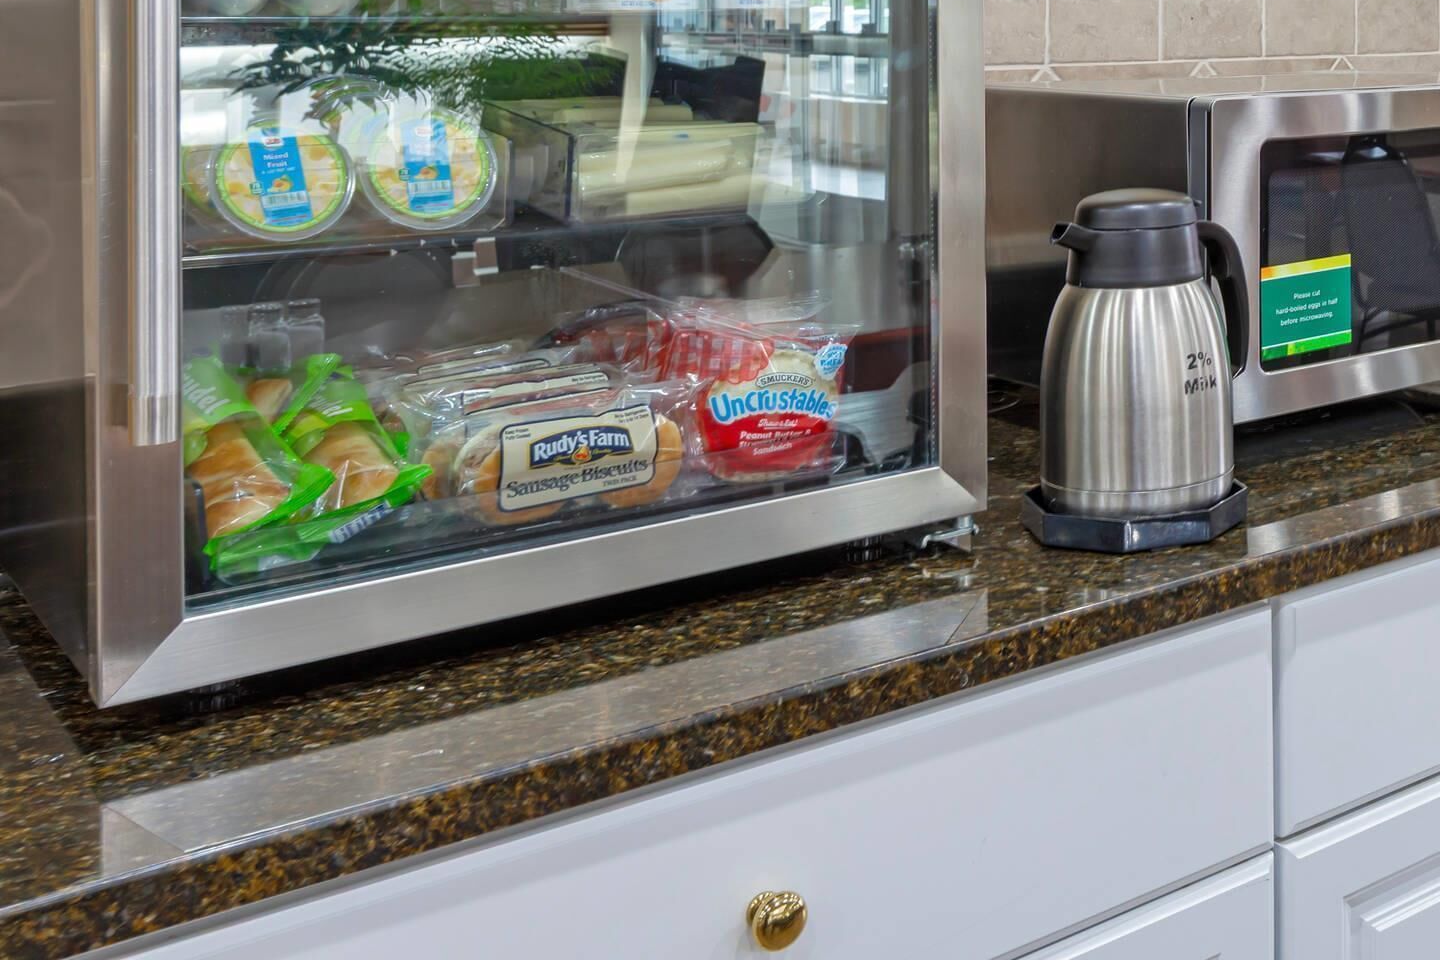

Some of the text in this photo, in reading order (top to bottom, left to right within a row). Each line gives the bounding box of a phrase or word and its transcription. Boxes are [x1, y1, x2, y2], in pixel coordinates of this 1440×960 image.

[263, 151, 288, 161] Mixed
[267, 161, 288, 169] Fruit
[1294, 291, 1311, 299] Please
[1276, 304, 1307, 314] hard-boiled
[1308, 302, 1321, 310] eggs
[1281, 317, 1298, 326] before
[1187, 352, 1211, 369] 2%
[1184, 374, 1217, 394] Milk
[711, 388, 836, 422] Uncrustables
[740, 431, 772, 440] Peanut
[533, 431, 588, 462] Rudy's
[588, 429, 630, 448] Farm
[753, 442, 792, 456] Sandwich
[506, 457, 649, 498] Sausage Biscuits
